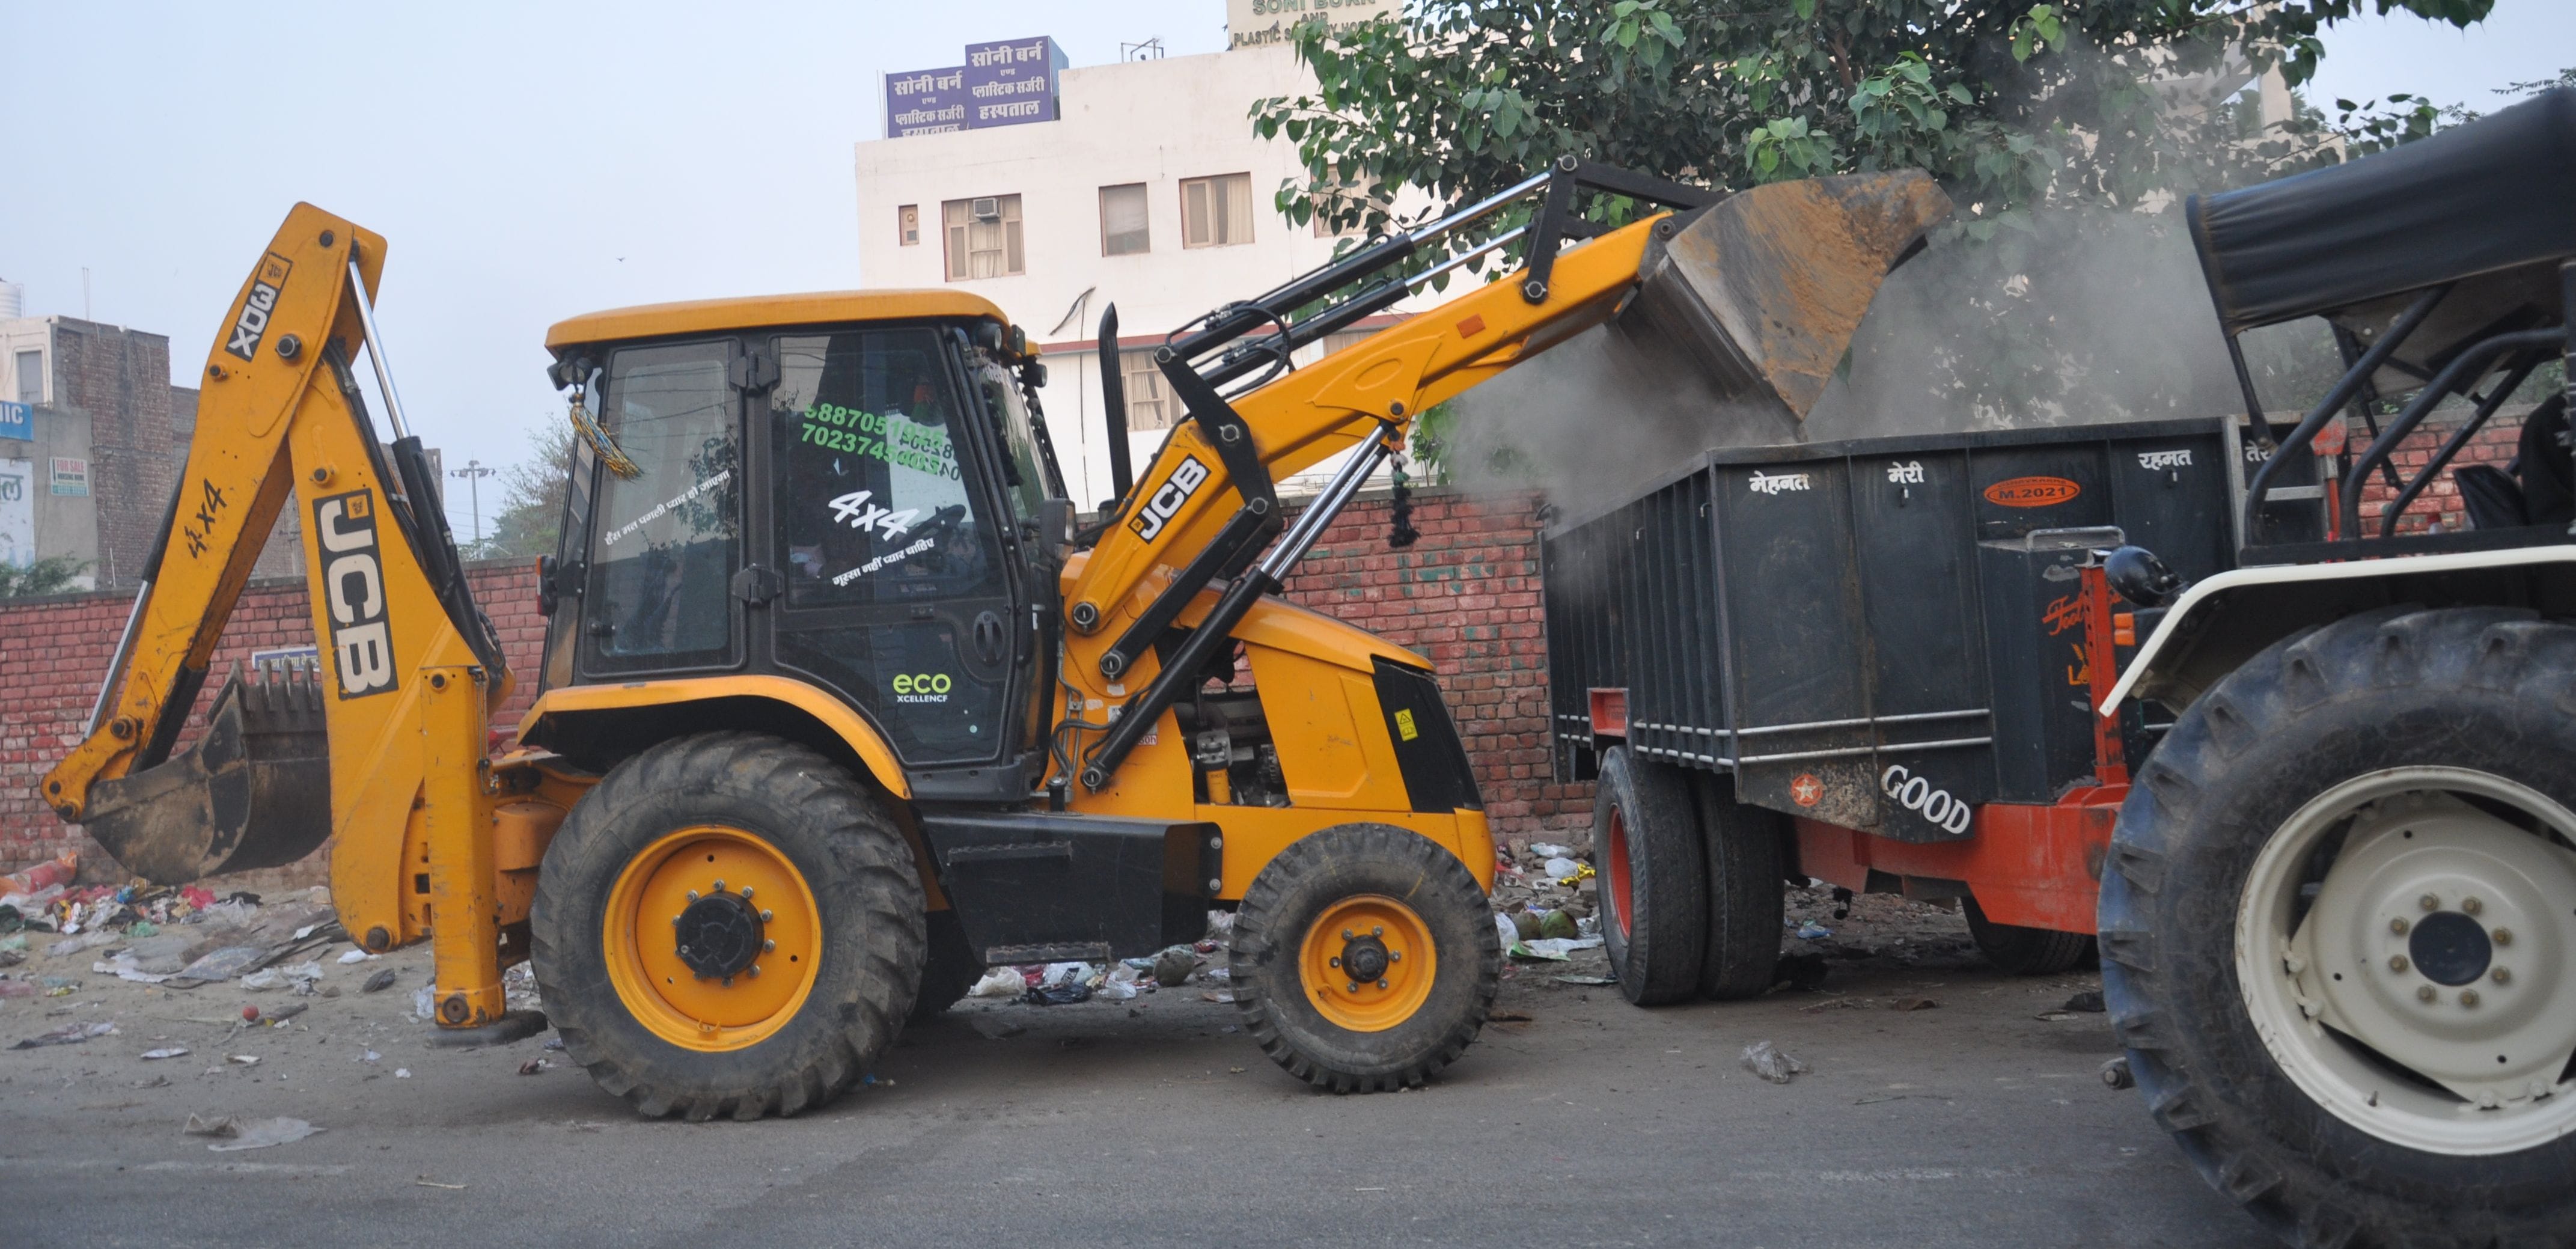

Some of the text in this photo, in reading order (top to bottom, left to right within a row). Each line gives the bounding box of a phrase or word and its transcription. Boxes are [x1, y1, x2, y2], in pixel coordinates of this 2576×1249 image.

[1234, 28, 1281, 47] PLASTIC
[971, 41, 1043, 67] सोनी बर्न
[894, 70, 962, 96] सोनी बर्न
[1000, 69, 1016, 77] एण्ड
[972, 76, 1045, 98] प्लास्टिक सर्जरी
[895, 104, 965, 126] प्लास्टिक सर्जरी
[978, 100, 1040, 120] हस्पताल
[228, 283, 276, 358] 3DX
[0, 403, 23, 425] IC
[56, 459, 84, 473] FOR SALE
[1749, 470, 1810, 495] मेहनत
[1887, 460, 1924, 484] मेरी
[2138, 450, 2193, 471] रहमत
[1140, 458, 1207, 540] JCB
[1999, 487, 2066, 499] M.2021
[320, 499, 391, 693] JCB
[893, 673, 951, 694] eco
[1881, 765, 1971, 834] GOOD
